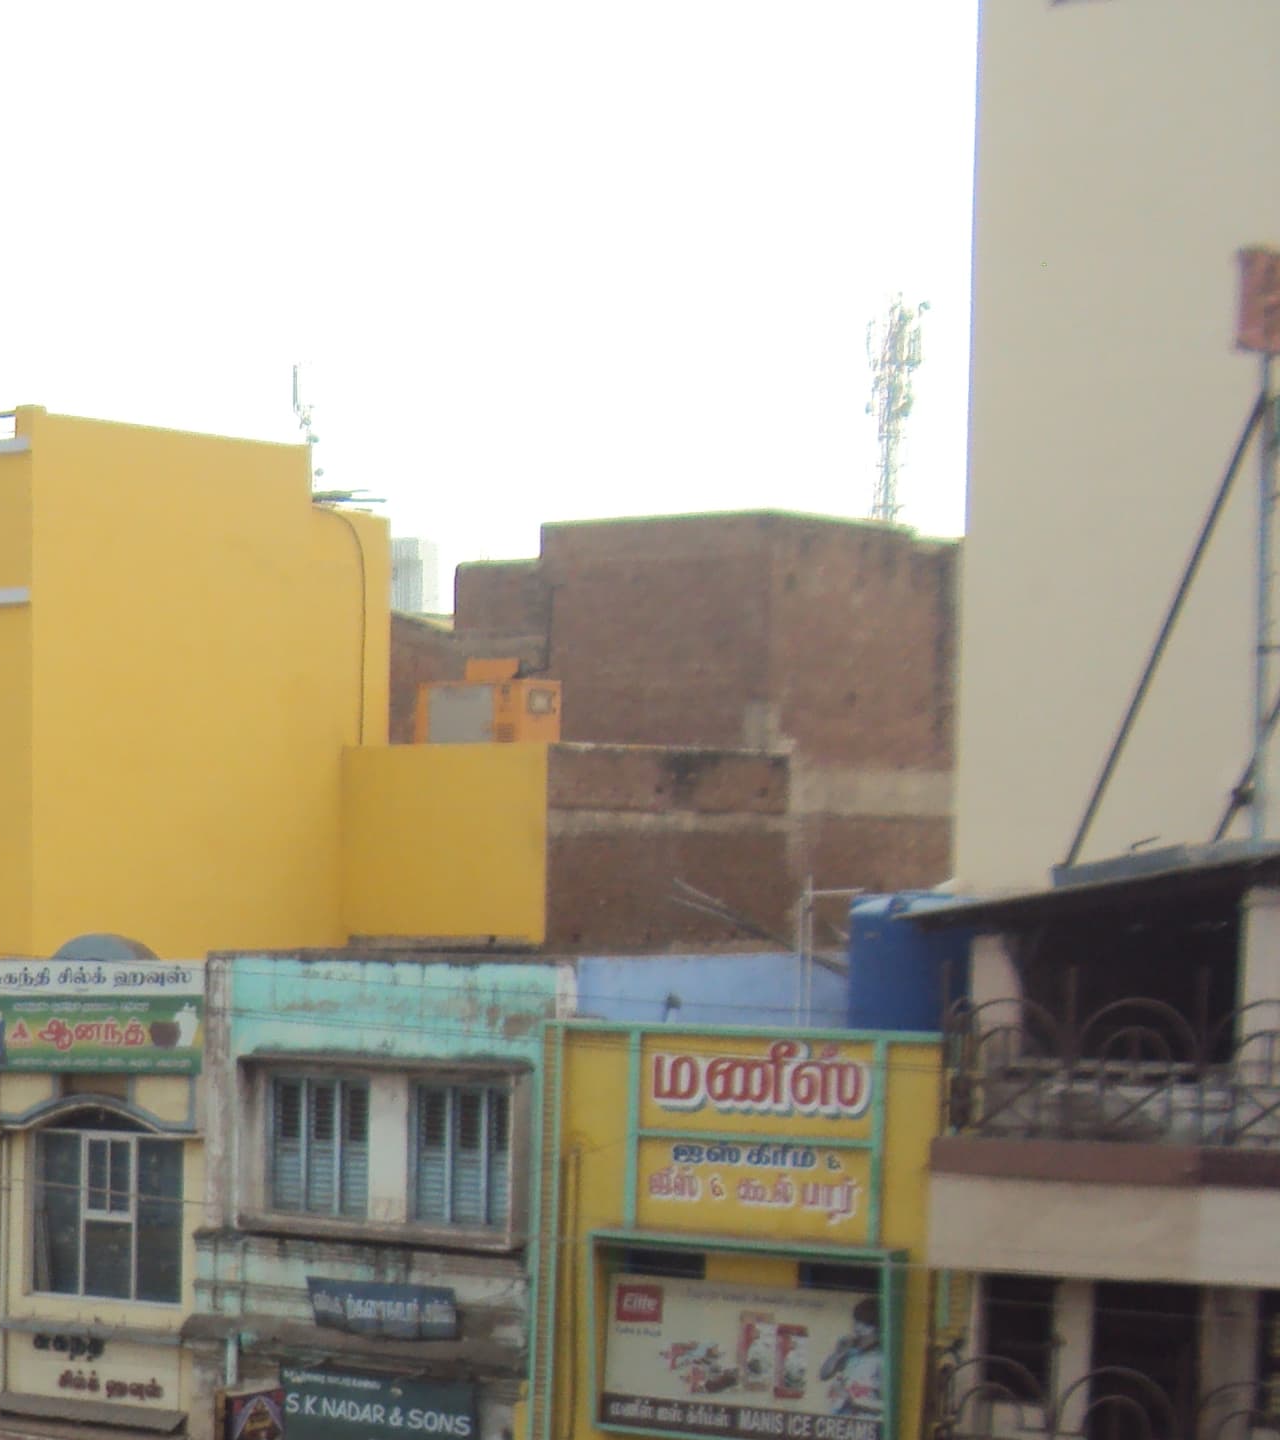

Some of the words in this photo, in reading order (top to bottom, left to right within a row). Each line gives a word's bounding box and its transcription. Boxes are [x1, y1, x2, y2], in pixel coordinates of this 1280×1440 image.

[113, 965, 192, 988] ஹவுஸ்
[653, 1039, 868, 1115] மணீஸ்
[671, 1141, 741, 1166] ஐஸ்
[622, 1292, 659, 1313] Elite
[322, 1396, 386, 1425] NADAR
[389, 1405, 404, 1428] &
[407, 1409, 472, 1437] SONS
[738, 1408, 784, 1434] MANIS
[787, 1414, 813, 1437] ICE
